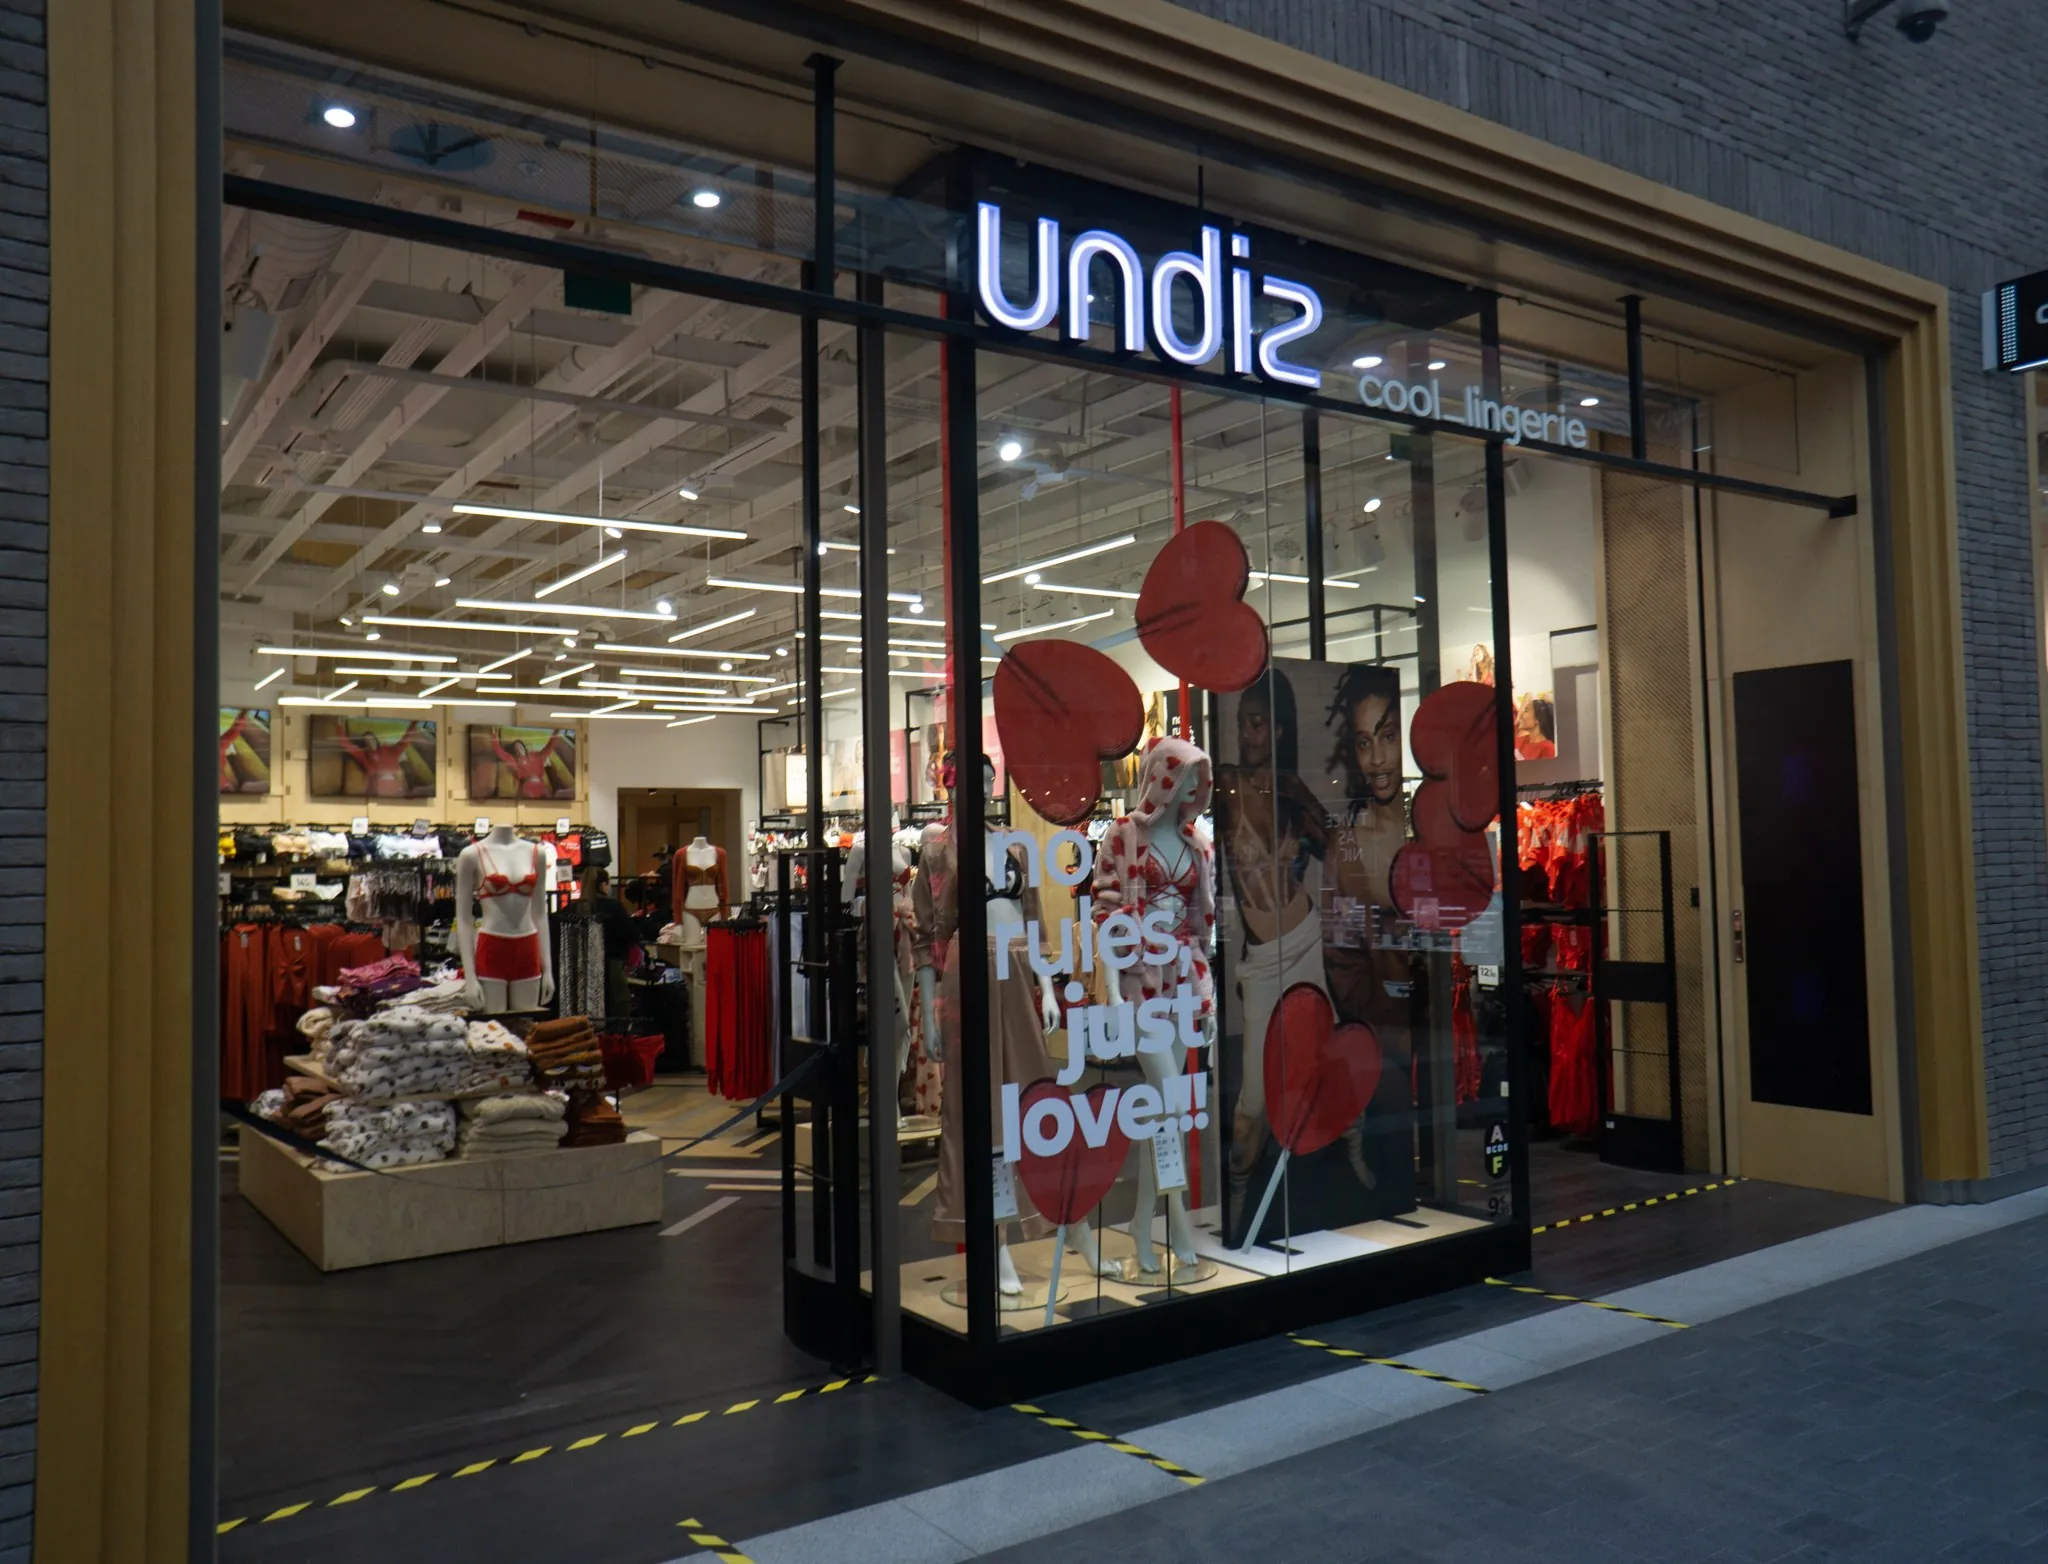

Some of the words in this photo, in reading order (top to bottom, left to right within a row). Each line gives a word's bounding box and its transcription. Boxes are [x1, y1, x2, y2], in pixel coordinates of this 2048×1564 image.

[978, 202, 1323, 389] undiz
[993, 829, 1092, 889] no
[996, 896, 1192, 980] rules,
[1056, 981, 1207, 1086] just
[1490, 1124, 1504, 1143] A
[1492, 1155, 1503, 1174] F
